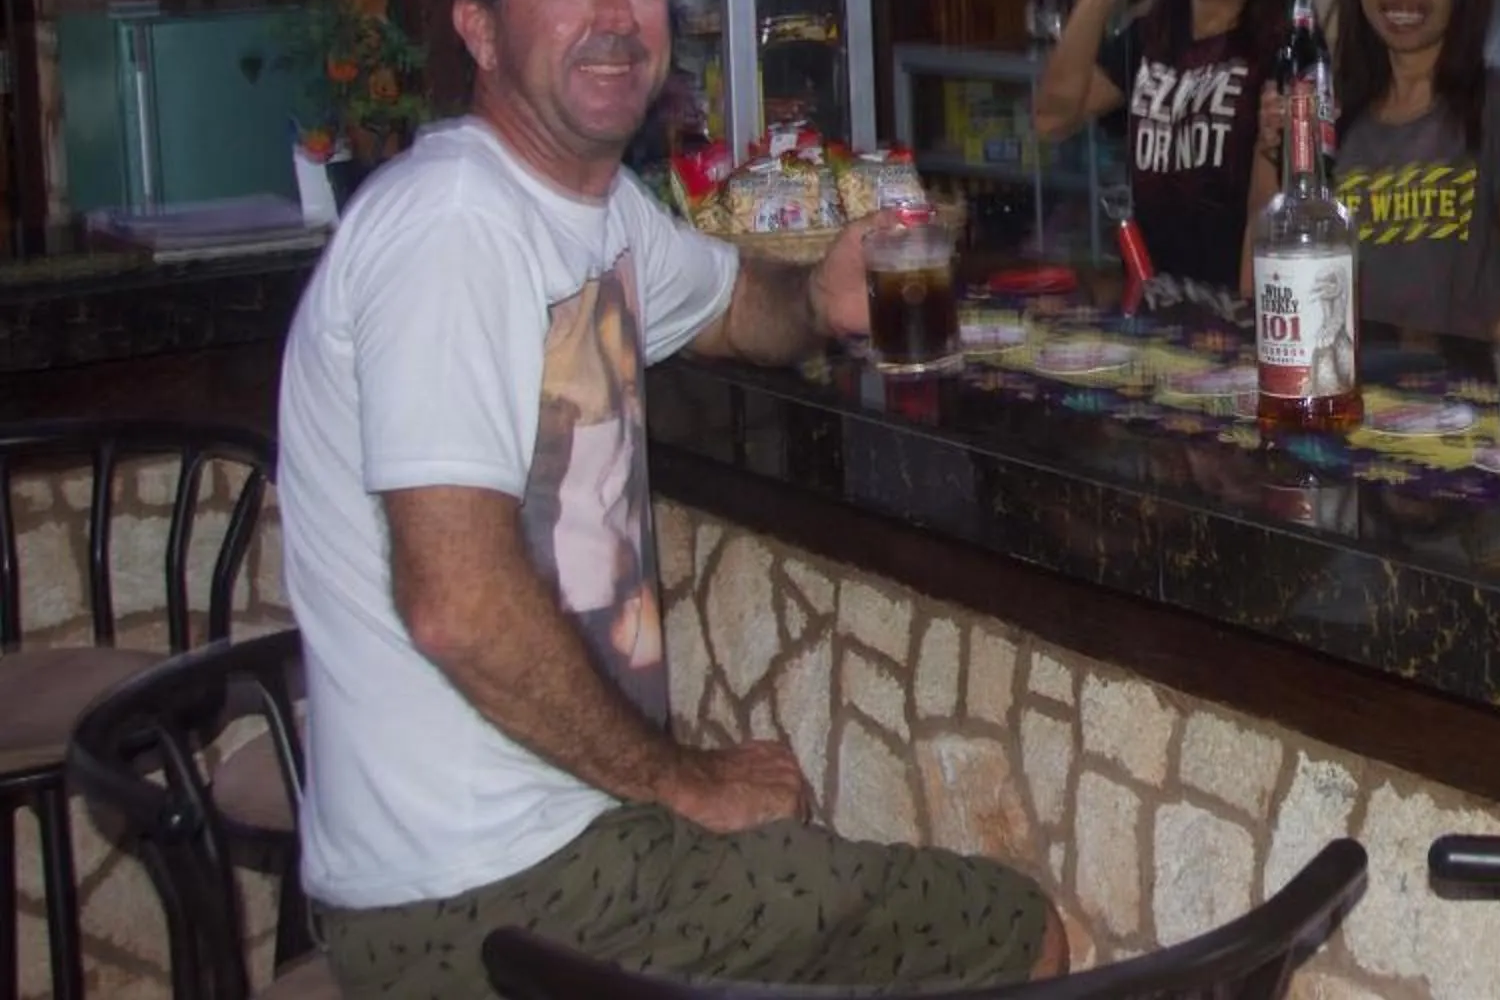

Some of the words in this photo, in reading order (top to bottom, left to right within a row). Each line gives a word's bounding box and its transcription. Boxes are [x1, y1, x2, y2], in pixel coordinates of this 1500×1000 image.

[1135, 119, 1172, 174] OR
[1175, 119, 1232, 171] NOT
[1370, 188, 1457, 222] WHITE
[1261, 294, 1299, 314] TURKEY
[1263, 282, 1293, 300] WILD
[1262, 314, 1301, 342] 101
